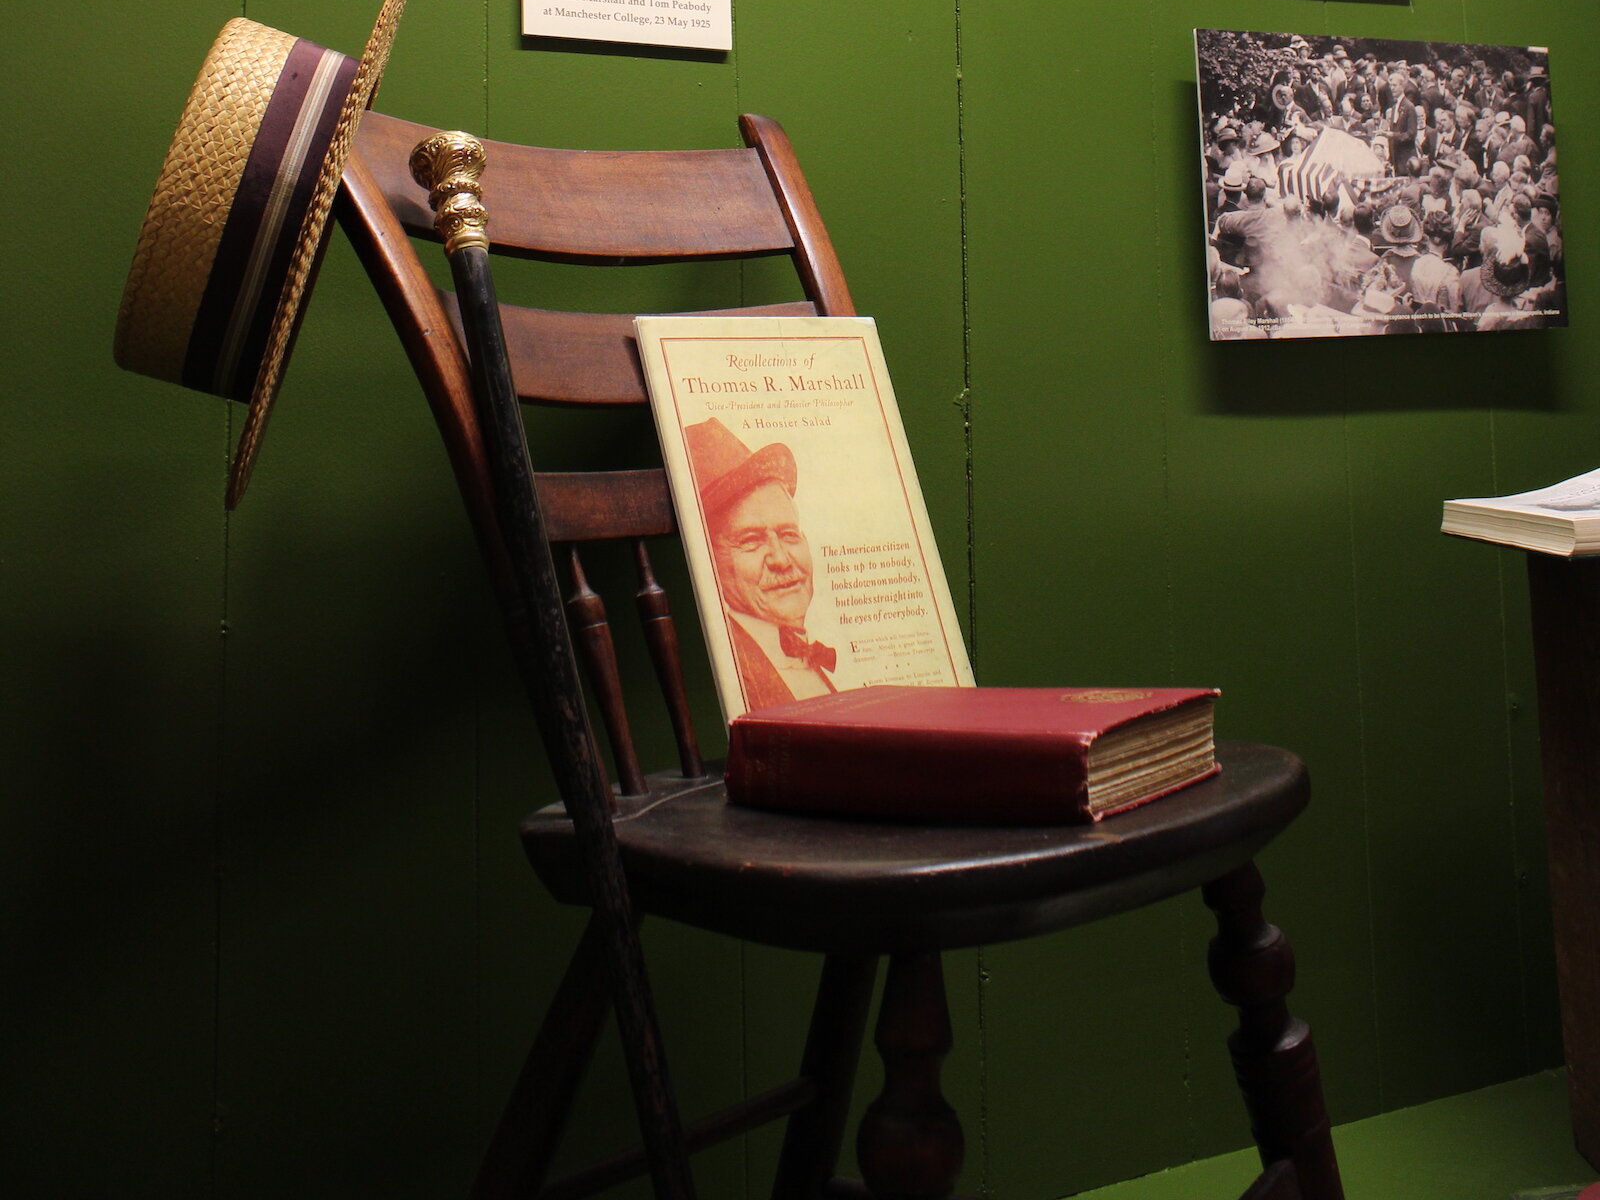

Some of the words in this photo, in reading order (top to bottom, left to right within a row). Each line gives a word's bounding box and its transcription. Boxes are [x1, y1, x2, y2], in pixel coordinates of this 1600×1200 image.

[672, 0, 712, 15] Peabody
[543, 8, 552, 16] at
[555, 7, 611, 21] Manchester
[614, 12, 653, 26] College,
[655, 16, 665, 25] 23
[668, 16, 689, 30] May
[691, 19, 711, 29] 1925
[726, 354, 797, 372] Recollections
[804, 353, 816, 370] of
[682, 377, 758, 394] Thomas
[788, 374, 865, 392] Marshall
[743, 419, 751, 429] A
[755, 417, 798, 429] Hoosier
[800, 416, 832, 427] Salad
[821, 546, 840, 558] The
[840, 544, 882, 556] American
[882, 541, 910, 552] citizen
[827, 562, 850, 574] looks
[854, 562, 866, 574] up
[869, 561, 877, 570] to
[832, 578, 853, 591] looks
[853, 577, 877, 589] down
[835, 596, 850, 607] but
[851, 593, 872, 606] looks
[873, 590, 906, 603] straight
[907, 590, 923, 599] into
[840, 613, 853, 625] the
[854, 614, 872, 625] eyes
[872, 610, 882, 622] of
